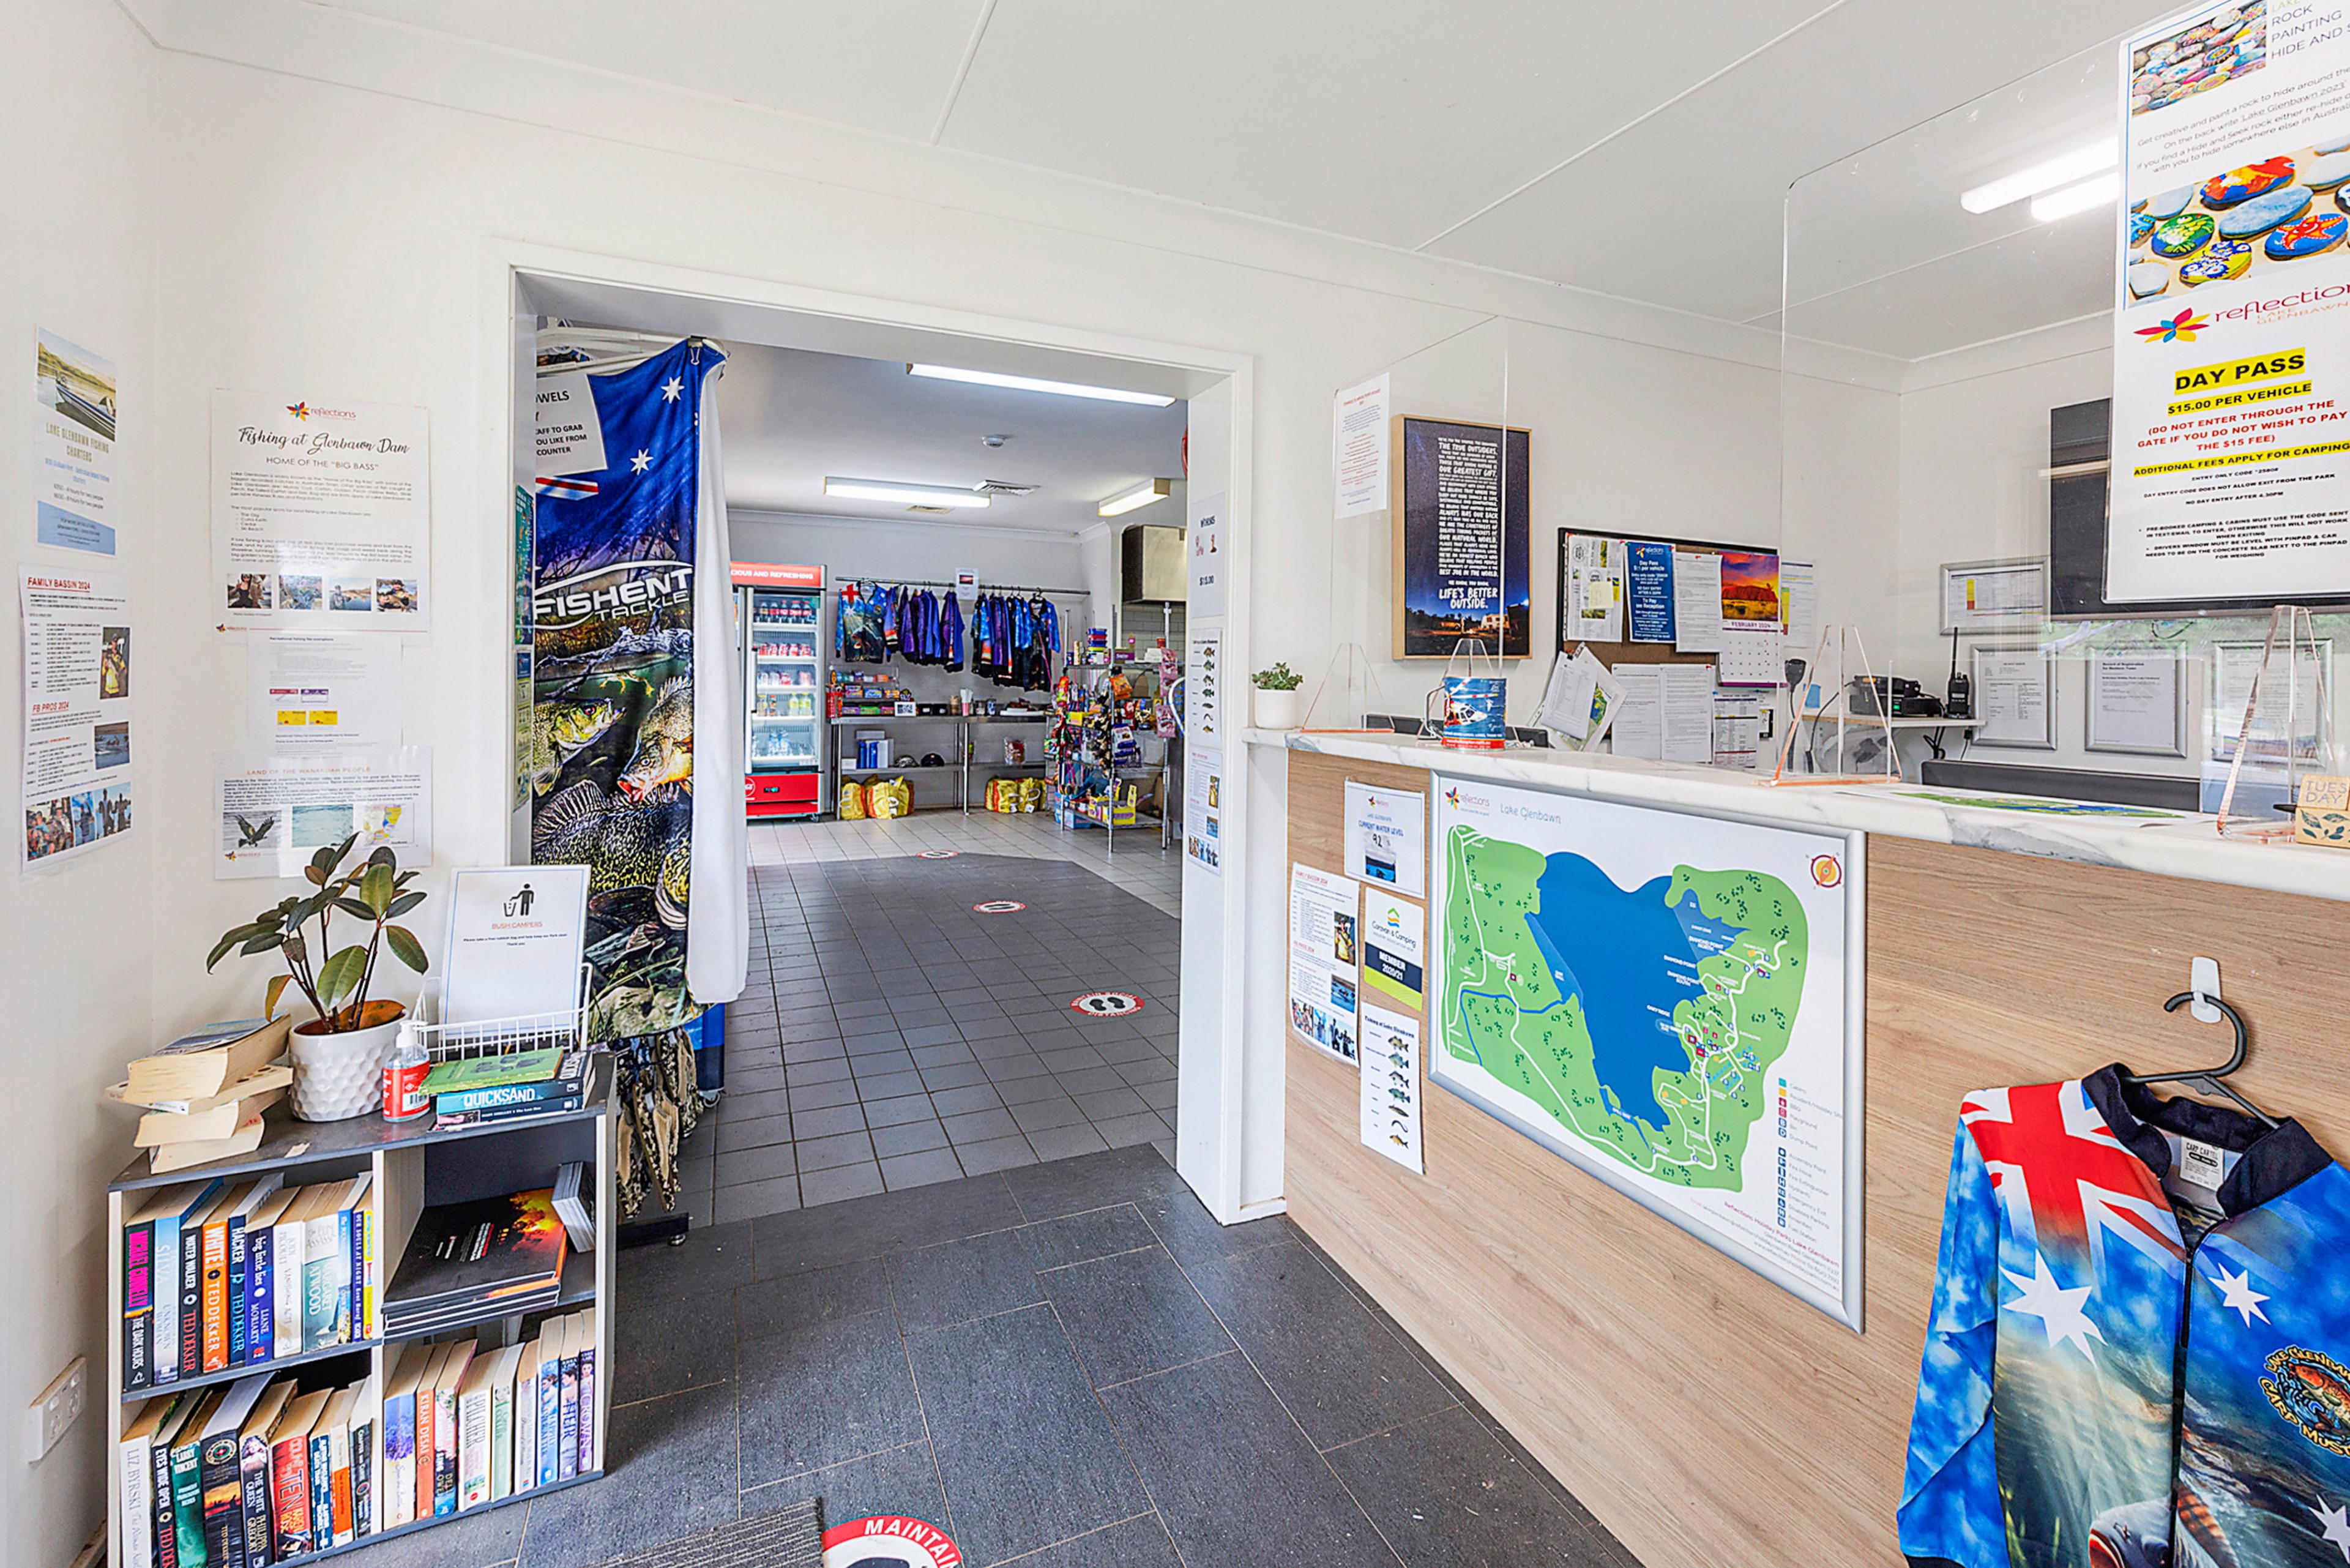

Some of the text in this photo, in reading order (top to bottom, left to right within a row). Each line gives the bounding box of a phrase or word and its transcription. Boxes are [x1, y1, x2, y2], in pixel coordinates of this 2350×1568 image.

[2272, 4, 2312, 26] ROCK
[2272, 10, 2342, 42] PAINTING
[2272, 27, 2343, 59] HIDE AND
[2138, 138, 2152, 147] Get
[2154, 126, 2189, 142] creative
[2191, 118, 2207, 129] and
[2209, 108, 2230, 125] paint
[2239, 97, 2258, 110] rock
[2261, 92, 2271, 102] to
[2273, 84, 2295, 97] hide
[2297, 72, 2333, 90] around
[2163, 140, 2177, 149] On
[2178, 133, 2193, 145] the
[2195, 125, 2215, 139] back
[2218, 117, 2239, 131] write
[2267, 91, 2318, 113] Glenbawn
[2176, 354, 2305, 390] DAY PASS
[536, 390, 569, 403] WELS
[2168, 383, 2312, 414] $15.00 PER VEHICLE
[311, 408, 356, 419] reflections
[2149, 400, 2335, 436] (DO NOT ENTER THROUGH THE
[239, 427, 410, 455] Fishing at Glenbawn Dam
[2138, 438, 2166, 448] GATE
[2183, 431, 2209, 441] YOU
[2212, 428, 2228, 437] DO
[2232, 424, 2258, 434] NOT
[2262, 419, 2294, 430] WISH
[2298, 416, 2316, 425] TO
[2321, 411, 2348, 422] PAY
[2197, 435, 2275, 451] THE $15 FEE)
[537, 446, 571, 456] COUNTER
[2134, 443, 2350, 476] ADDITIONAL FEES APPLY FOR CAMPING
[28, 577, 53, 587] FAMILY
[534, 568, 693, 621] FISHENT
[1439, 588, 1498, 599] LIFE'S BETTER
[595, 590, 689, 621] TACKLE
[1450, 598, 1488, 609] OUTSIDE.
[2306, 793, 2342, 804] DAY
[2307, 780, 2347, 793] TUES
[1501, 804, 1562, 824] Lake Glenbawn
[463, 1088, 535, 1107] QUICKSAND
[2187, 1143, 2198, 1152] CARP
[231, 1227, 244, 1264] HACKER
[185, 1234, 196, 1290] WATER WALKER
[309, 1265, 321, 1316] ATWOOD
[208, 1281, 220, 1353] TED DEKKER
[233, 1291, 244, 1353] TED DEKKER
[250, 1302, 260, 1345] MORIARTY
[260, 1308, 270, 1334] LIANE
[184, 1310, 196, 1373] TED DEKKER
[132, 1346, 144, 1370] HOURS
[2266, 1351, 2289, 1372] LAKE
[2260, 1378, 2299, 1424] CARP
[420, 1394, 429, 1454] KIRAN DESAI
[127, 1449, 141, 1510] LIZ BYRSKI
[155, 1447, 170, 1509] EYES WIDE OPEN
[255, 1470, 265, 1514] THE WHITE
[246, 1480, 256, 1508] QUEEN
[160, 1525, 174, 1548] TED
